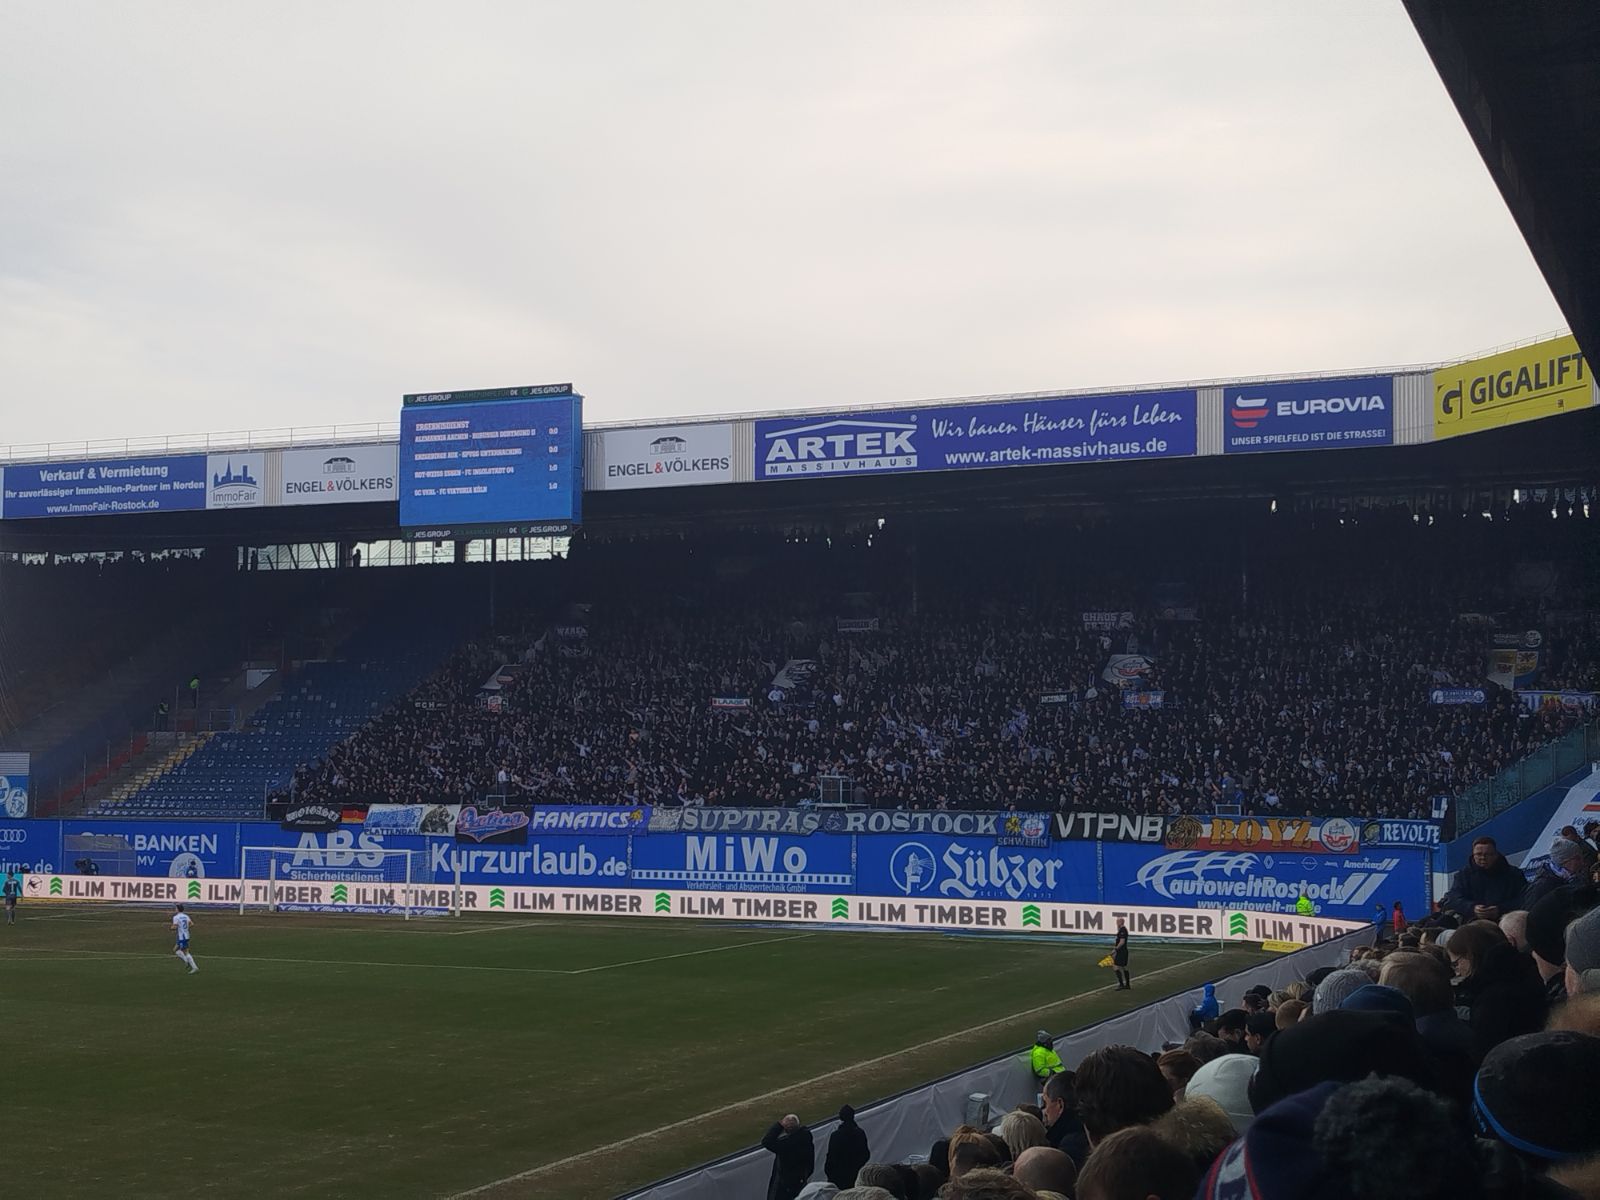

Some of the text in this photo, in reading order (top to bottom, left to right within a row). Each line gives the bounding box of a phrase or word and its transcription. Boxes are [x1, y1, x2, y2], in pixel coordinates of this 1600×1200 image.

[1470, 353, 1583, 406] GIGALIFT
[1277, 395, 1385, 417] EUROVIA
[932, 403, 1182, 438] Wir bauen Häuser fürs Leben
[765, 430, 917, 462] ARTEK
[1231, 429, 1387, 446] UNSER SPIELFELD IST DIE STRASSE!
[945, 438, 1168, 464] www.artek-massivhaus.de
[40, 465, 168, 482] Verkauf & Vermietung
[608, 457, 730, 477] ENGEL&VÖLKERS
[770, 458, 913, 473] MASSIVHAUS
[19, 487, 74, 499] zuverlässiger
[75, 483, 157, 496] Immobilien-Partner
[159, 482, 171, 491] im
[173, 479, 205, 491] Norden
[213, 489, 257, 504] ImmoFair
[286, 477, 394, 494] ENGEL&VÖLKERS
[47, 499, 160, 515] www.ImmoFair-Rostock.de
[533, 811, 630, 830] FANATICS
[680, 809, 821, 833] SUPTRAS
[842, 811, 999, 835] ROSTOCK
[1056, 812, 1164, 842] VTPNB
[1211, 818, 1312, 848] BOYZ
[1383, 822, 1440, 844] REVOLTE
[292, 830, 385, 867] ABS
[431, 842, 628, 877] Kurzurlaub.de
[686, 835, 807, 874] MiWo
[0, 858, 53, 875] irne.de
[290, 870, 385, 882] Sicherheitsdienst
[940, 841, 1064, 900] Lübzer
[69, 881, 177, 899] ILIM TIMBER
[209, 884, 322, 902] ILIM TIMBER
[355, 888, 477, 908] ILIM TIMBER
[514, 892, 642, 912] ILIM TIMBER
[680, 897, 817, 919] ILIM TIMBER
[859, 902, 1007, 926] ILIM TIMBER
[1051, 909, 1103, 930] ILIM
[1255, 918, 1293, 945] ILIM
